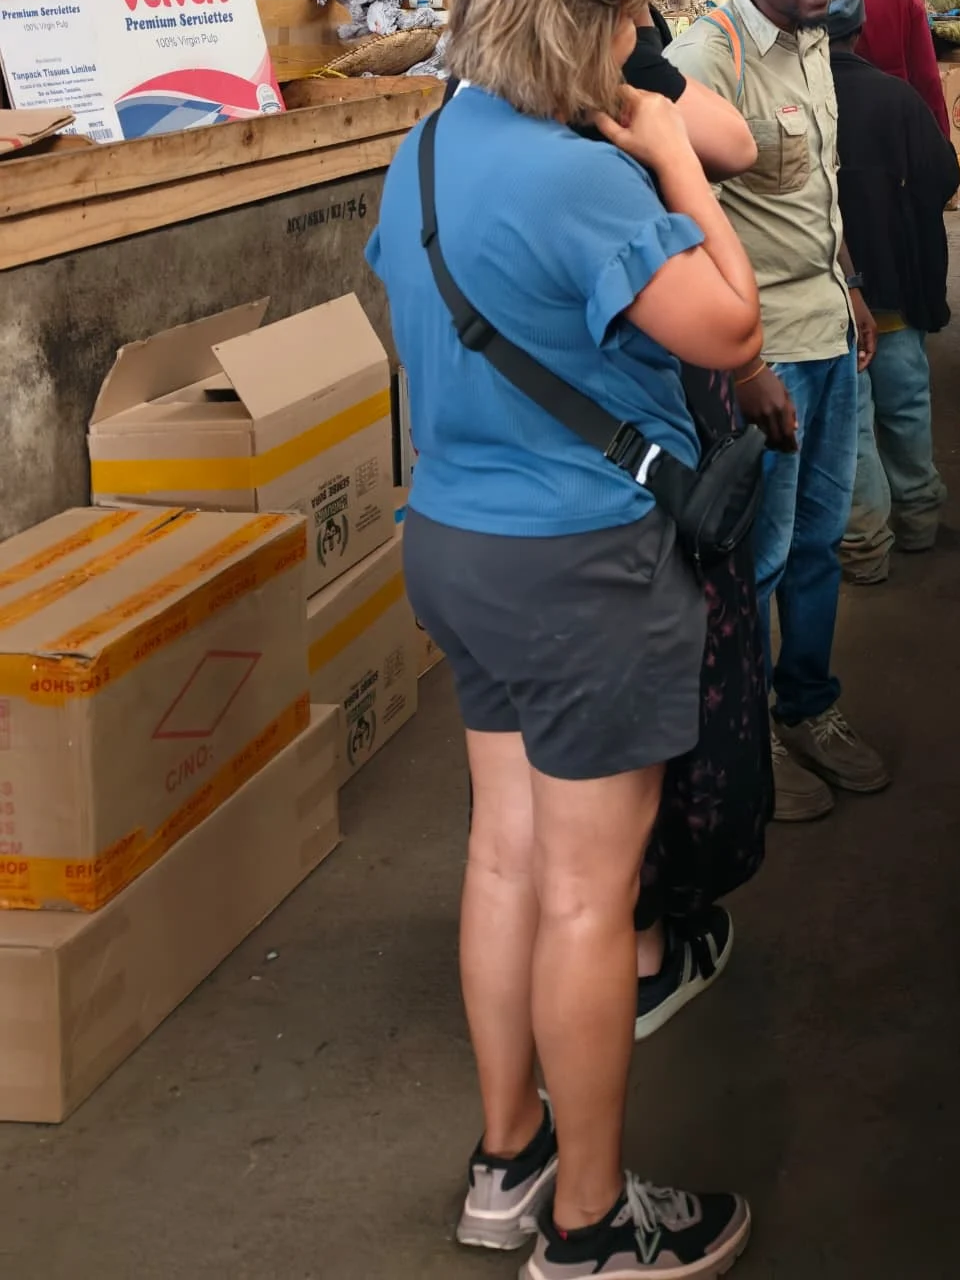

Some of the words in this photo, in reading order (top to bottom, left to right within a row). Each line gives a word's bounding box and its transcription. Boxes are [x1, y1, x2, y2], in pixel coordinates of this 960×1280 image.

[2, 8, 39, 20] Premium
[40, 5, 81, 17] Serviettes
[125, 15, 177, 31] Premium
[179, 11, 234, 27] Serviettes
[156, 35, 178, 48] 100%
[178, 35, 200, 47] Virgin
[201, 33, 218, 45] Pulp
[11, 69, 42, 81] Tanpack
[42, 67, 70, 78] Tissues
[70, 63, 97, 74] Limited
[133, 635, 161, 661] SHOP
[30, 679, 75, 693] SHOP
[166, 745, 214, 793] C/NO:
[0, 862, 28, 875] HOP
[65, 860, 102, 878] ERIC
